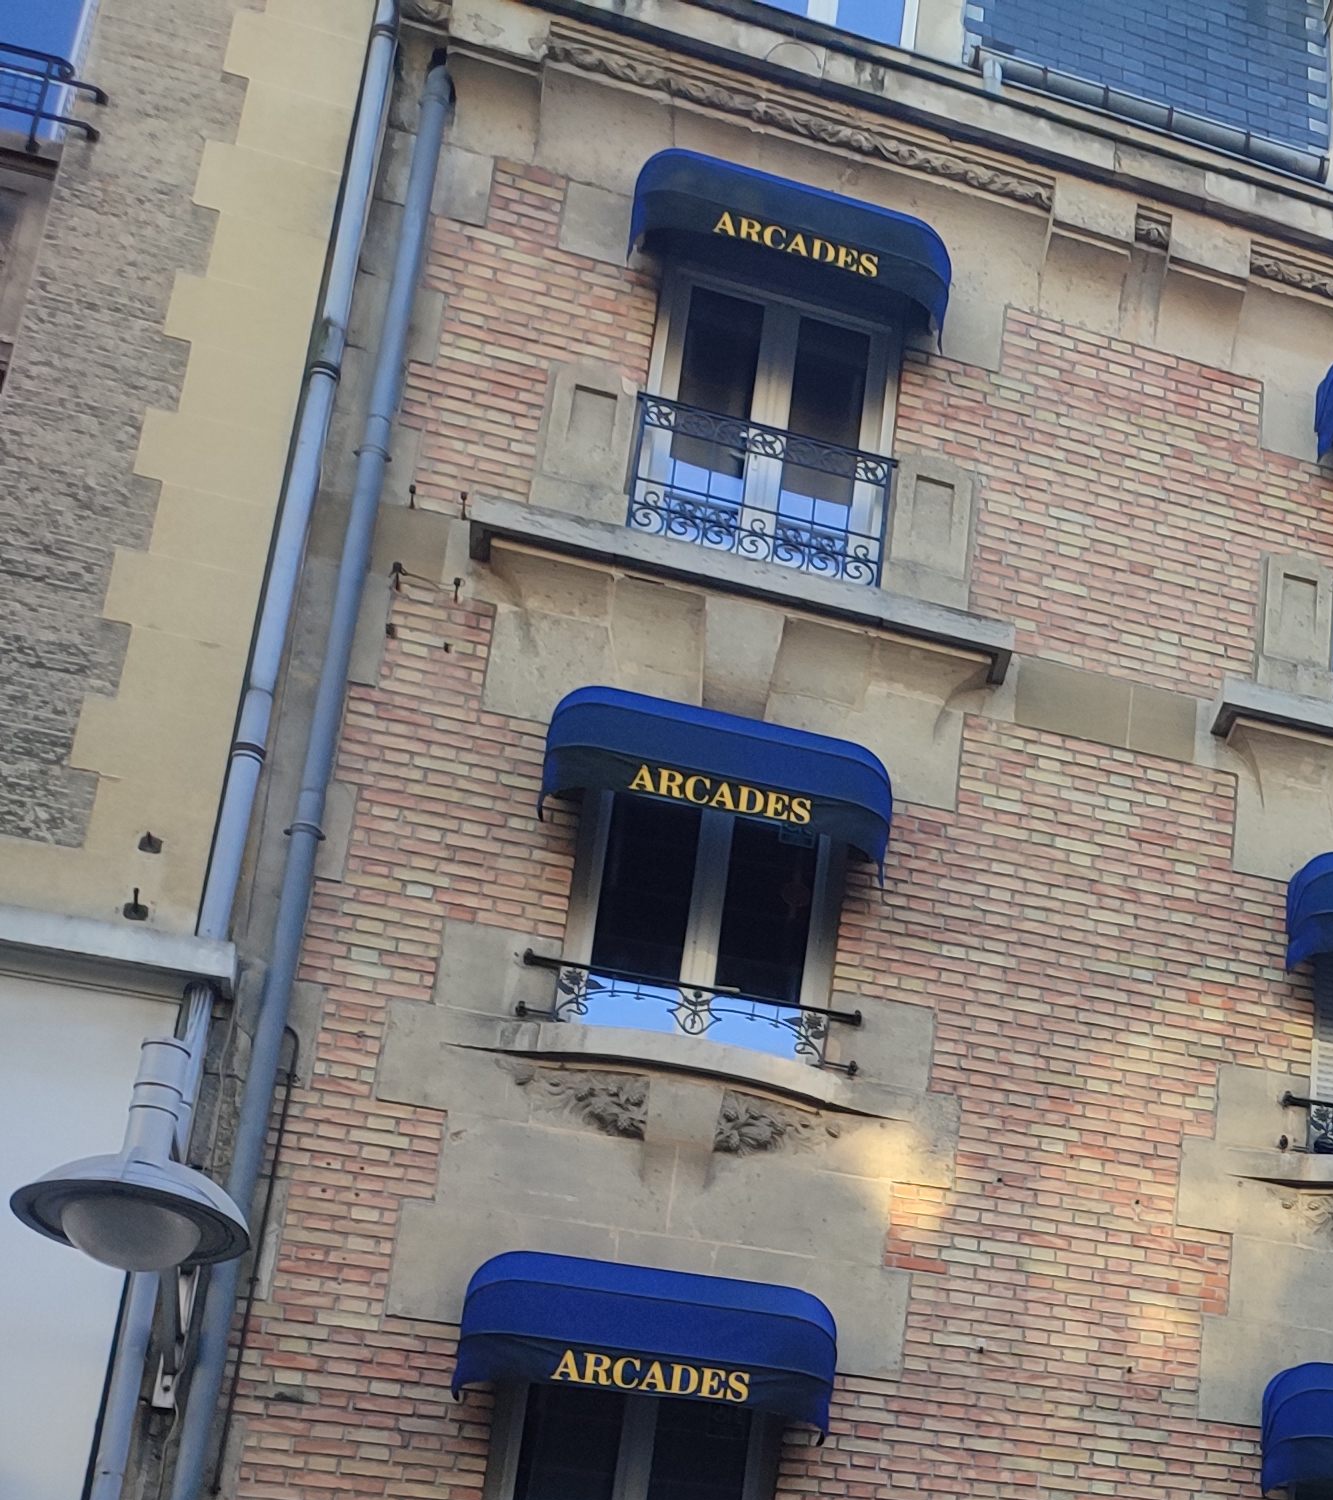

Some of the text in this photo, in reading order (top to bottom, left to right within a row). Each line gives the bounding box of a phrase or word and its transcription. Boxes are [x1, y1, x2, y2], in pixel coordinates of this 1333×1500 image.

[712, 211, 879, 278] ARCADES
[629, 764, 812, 825] ARCADES
[551, 1349, 750, 1402] ARCADES
